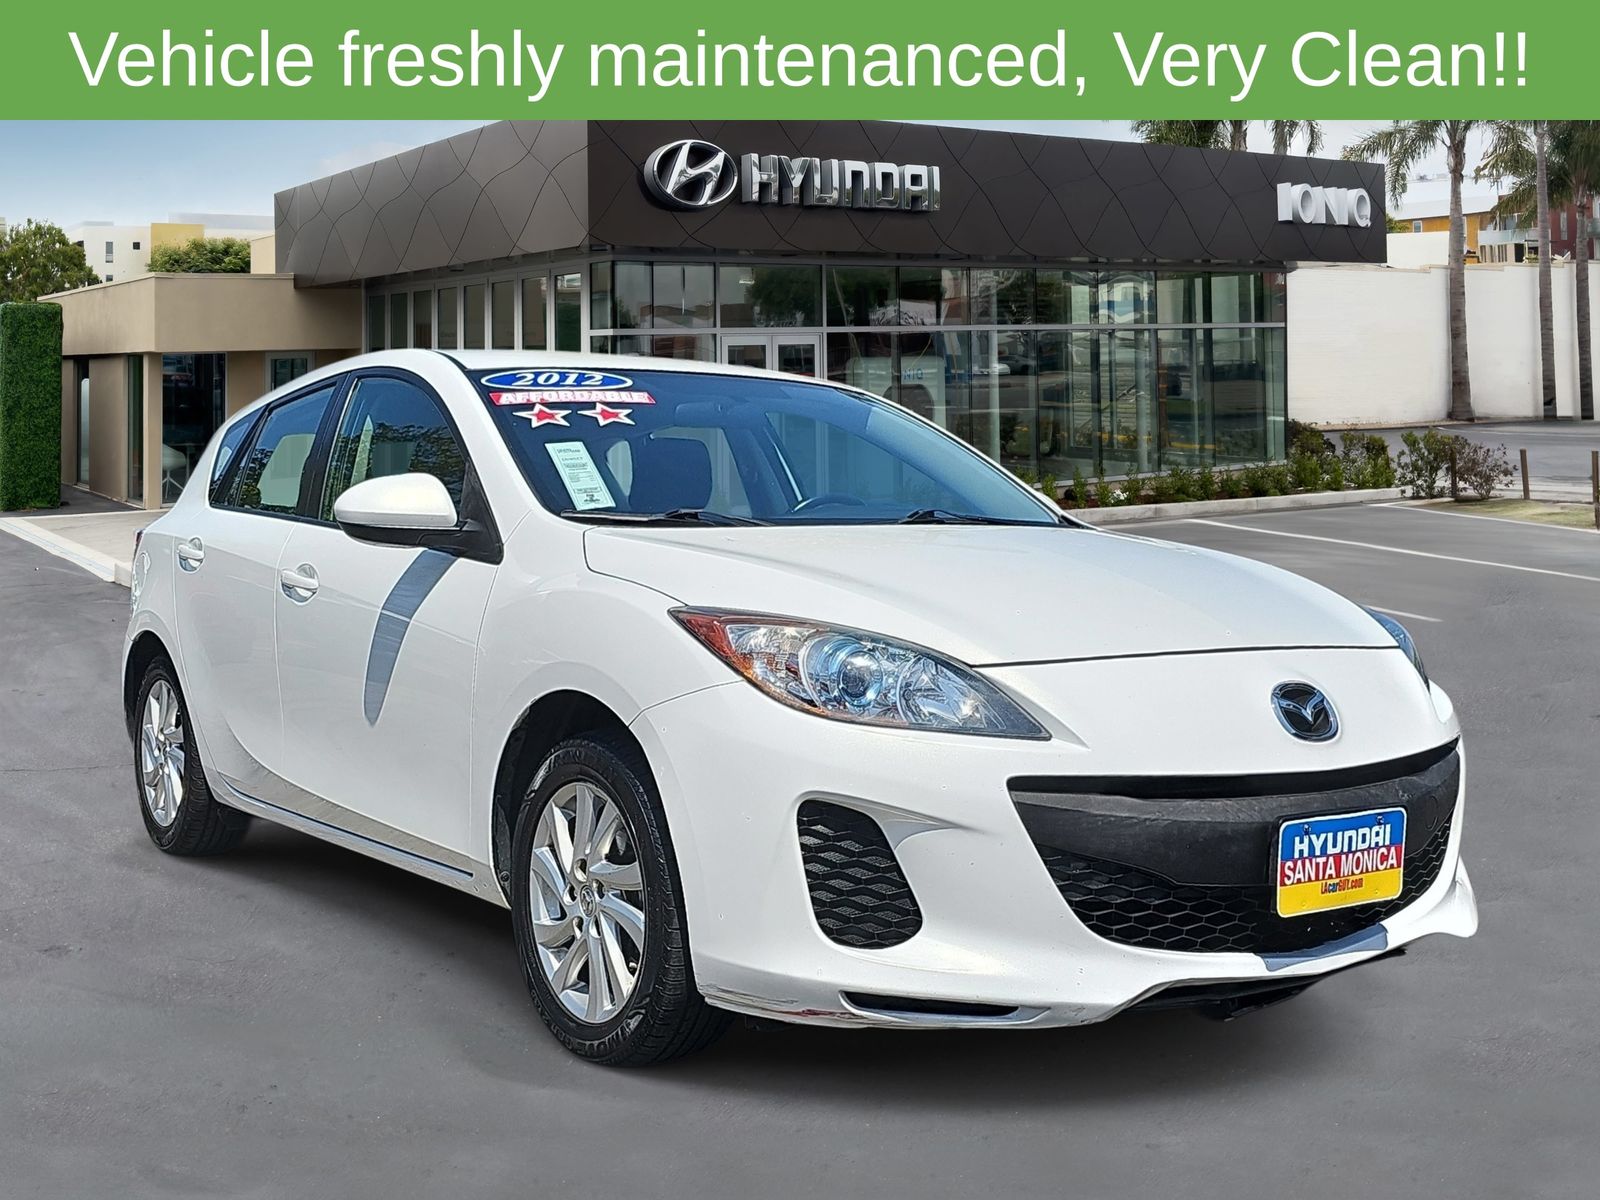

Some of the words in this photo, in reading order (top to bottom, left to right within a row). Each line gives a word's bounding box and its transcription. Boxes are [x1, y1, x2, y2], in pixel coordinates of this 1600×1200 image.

[741, 153, 941, 211] HYUNDAI
[1277, 182, 1371, 227] IONIQ
[501, 391, 648, 405] AFFORDABLE
[512, 372, 604, 387] 2012
[1294, 824, 1391, 859] HYUNDAI
[1284, 857, 1336, 886] SANTA
[1340, 846, 1397, 877] MONICA
